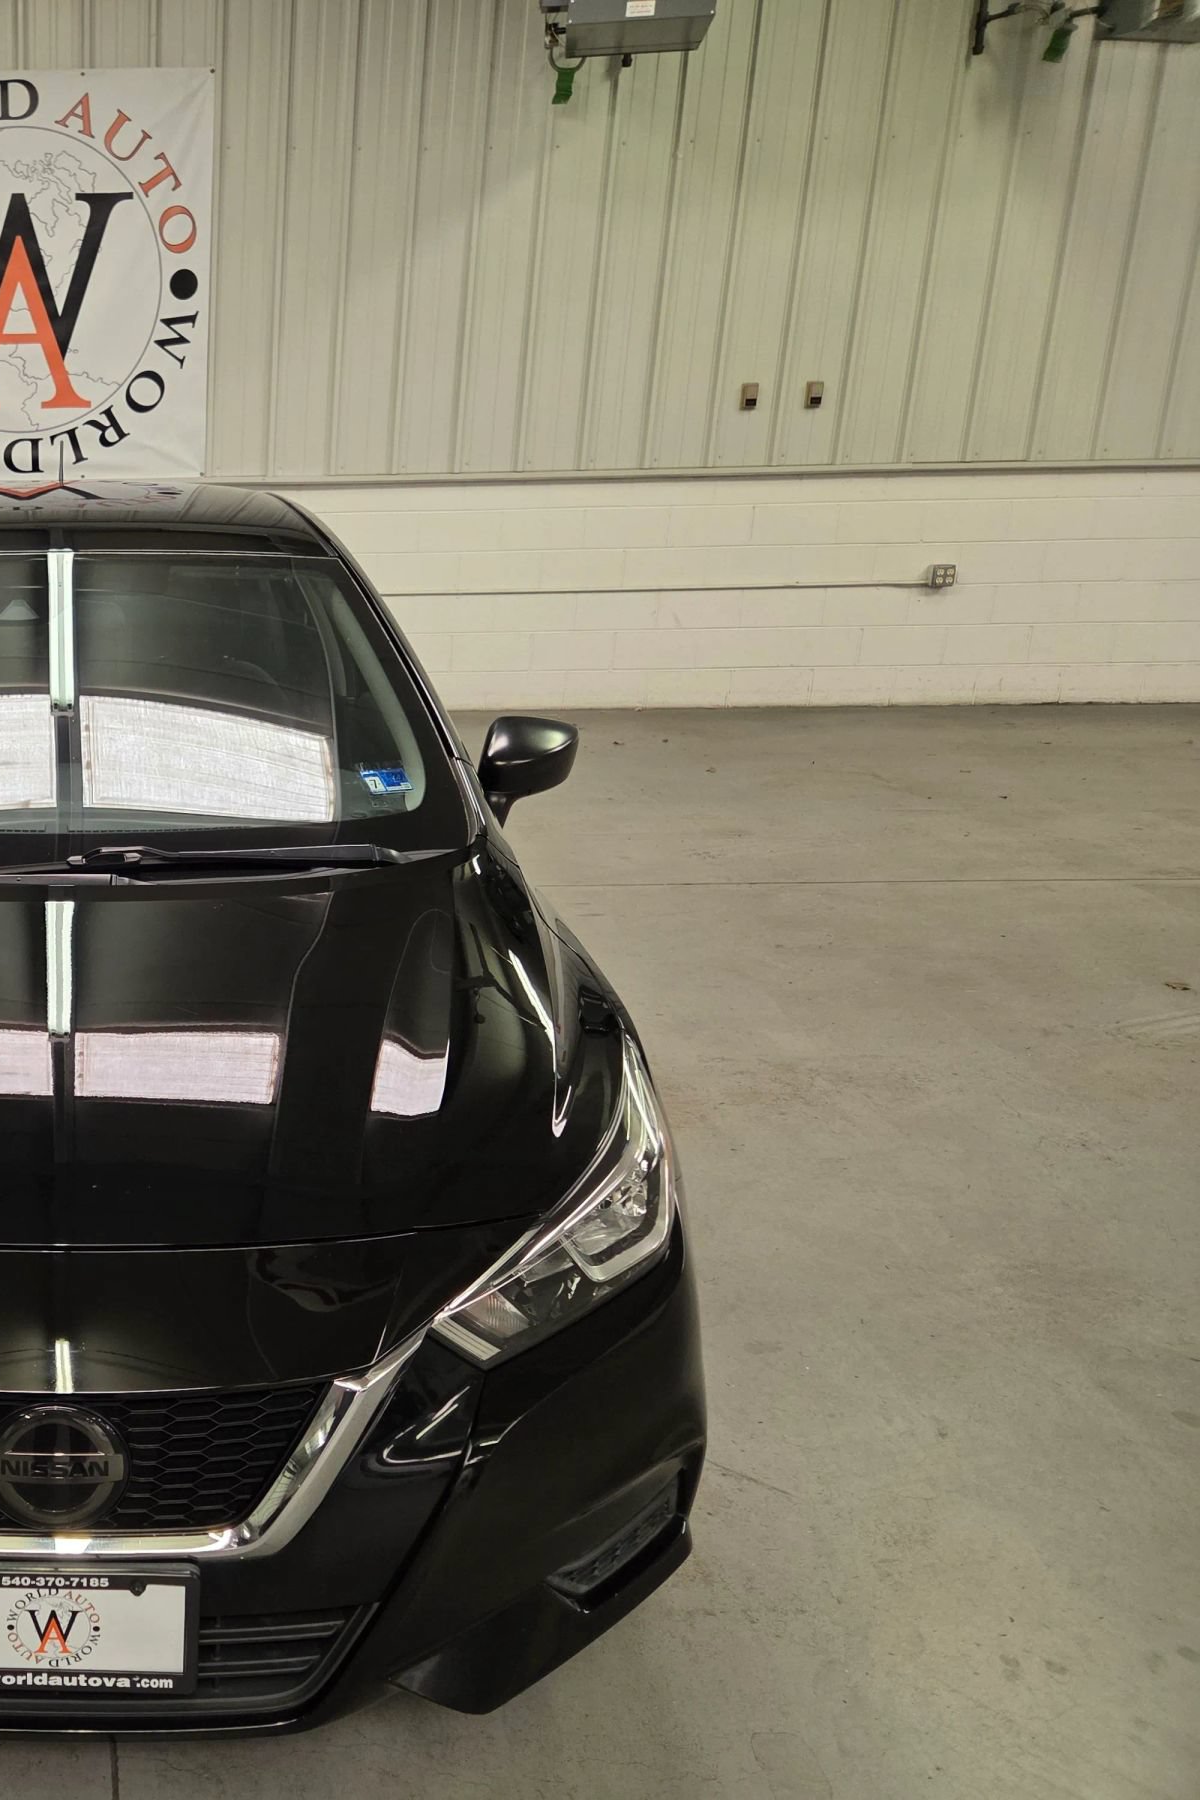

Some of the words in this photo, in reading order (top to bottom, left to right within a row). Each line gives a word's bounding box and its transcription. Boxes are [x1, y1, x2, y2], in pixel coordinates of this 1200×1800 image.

[55, 92, 197, 254] AUTO
[3, 310, 199, 474] WORLD
[1, 1460, 109, 1479] NISSAN
[1, 1576, 109, 1588] 540-370-7185
[7, 1588, 59, 1622] WORLD
[64, 1591, 100, 1623] AUTO
[7, 1632, 44, 1664] AUTO
[49, 1634, 100, 1667] WORLD
